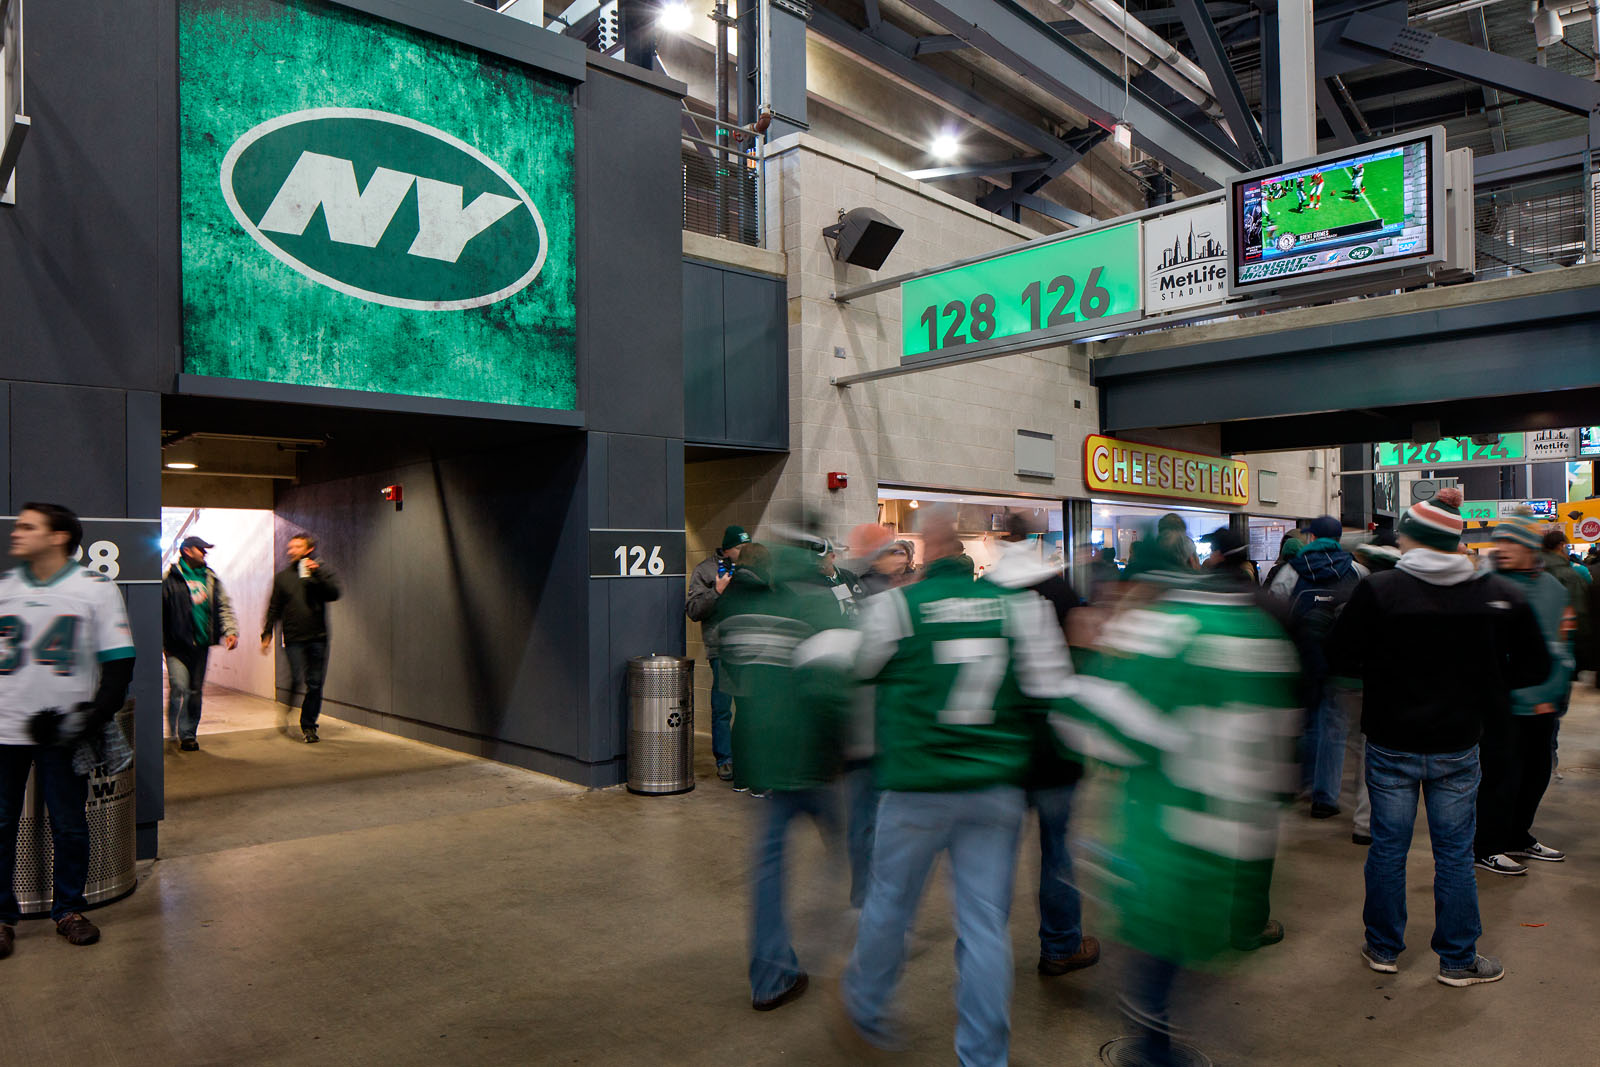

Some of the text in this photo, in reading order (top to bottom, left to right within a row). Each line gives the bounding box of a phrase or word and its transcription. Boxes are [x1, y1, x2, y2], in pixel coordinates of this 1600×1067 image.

[256, 150, 524, 263] NY
[1399, 242, 1414, 251] SAP
[1240, 263, 1309, 281] MATCHUP
[1245, 255, 1318, 274] TONIGHT'S
[1160, 265, 1227, 291] MetLife
[1161, 281, 1224, 300] STADIUM
[920, 266, 1111, 351] 128 126
[1393, 436, 1509, 465] 126 124
[1535, 442, 1569, 450] MetLife
[1092, 445, 1247, 497] CHEESESTEAK
[1469, 508, 1490, 519] 123
[614, 545, 665, 576] 126
[931, 638, 1009, 725] 7
